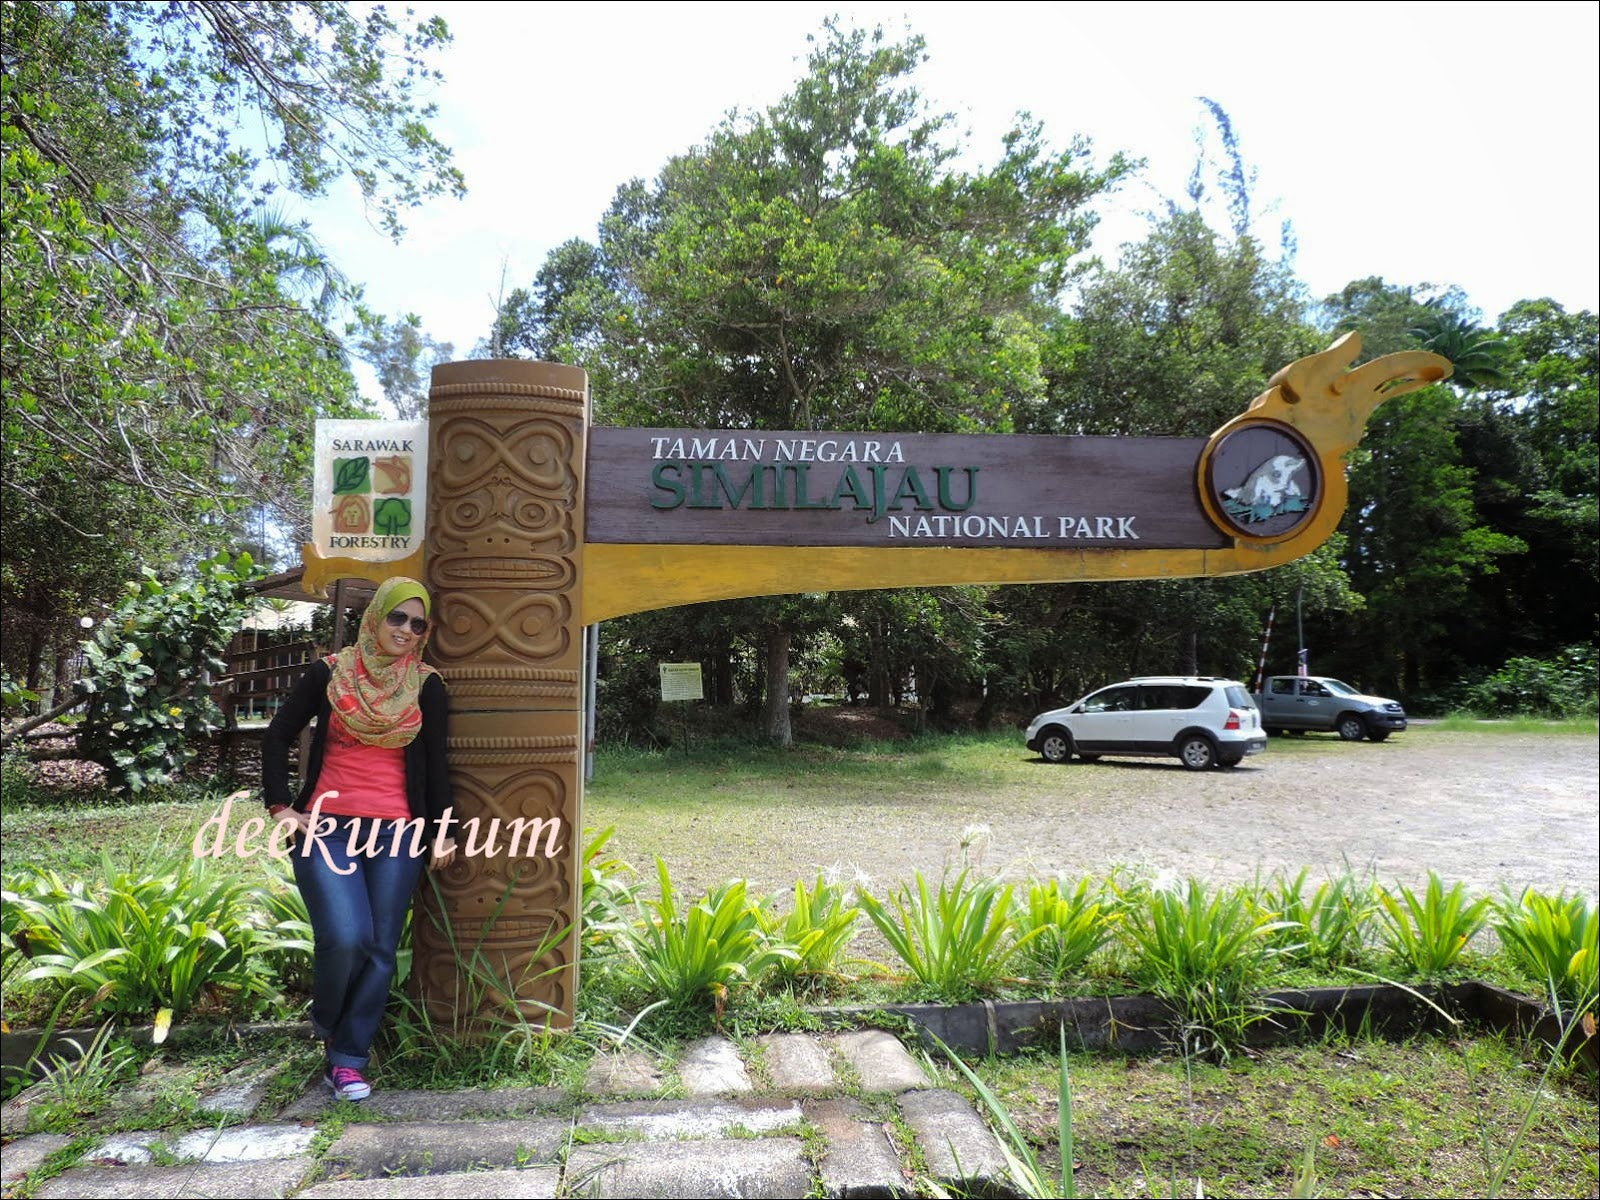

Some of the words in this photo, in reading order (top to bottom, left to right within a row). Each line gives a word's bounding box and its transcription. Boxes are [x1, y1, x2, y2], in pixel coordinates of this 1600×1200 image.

[332, 439, 413, 451] SARAWAK
[650, 437, 765, 461] TAMAN
[774, 440, 905, 463] NEGARA
[650, 462, 980, 523] SIMILAJAU
[888, 515, 1049, 539] NATIONAL
[1057, 516, 1140, 540] PARK
[329, 536, 411, 549] FORESTRY
